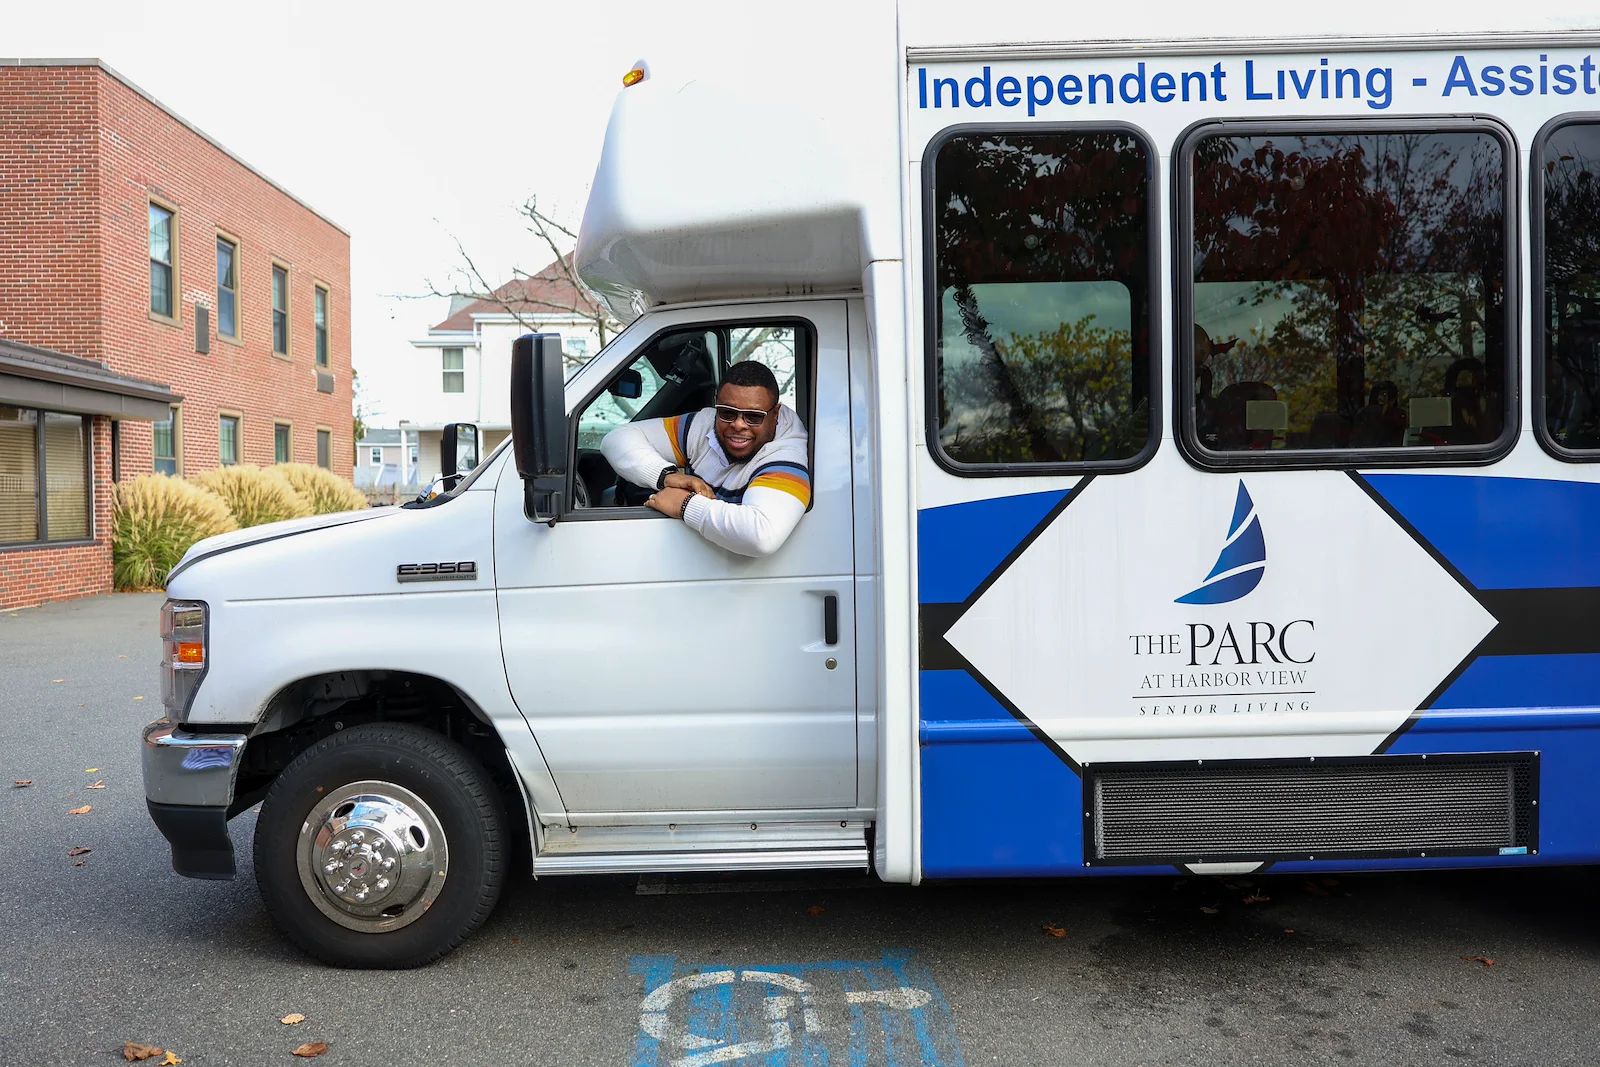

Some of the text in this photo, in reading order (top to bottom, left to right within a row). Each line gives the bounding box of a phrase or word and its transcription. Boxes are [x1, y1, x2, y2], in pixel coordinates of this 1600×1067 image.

[918, 62, 1228, 117] Independent
[1441, 54, 1600, 97] Assist
[398, 562, 476, 575] E-350
[1129, 620, 1316, 666] THE PARC
[1140, 670, 1308, 689] AT HARBOR VIEW
[1139, 701, 1310, 716] SENIOR LIVING
